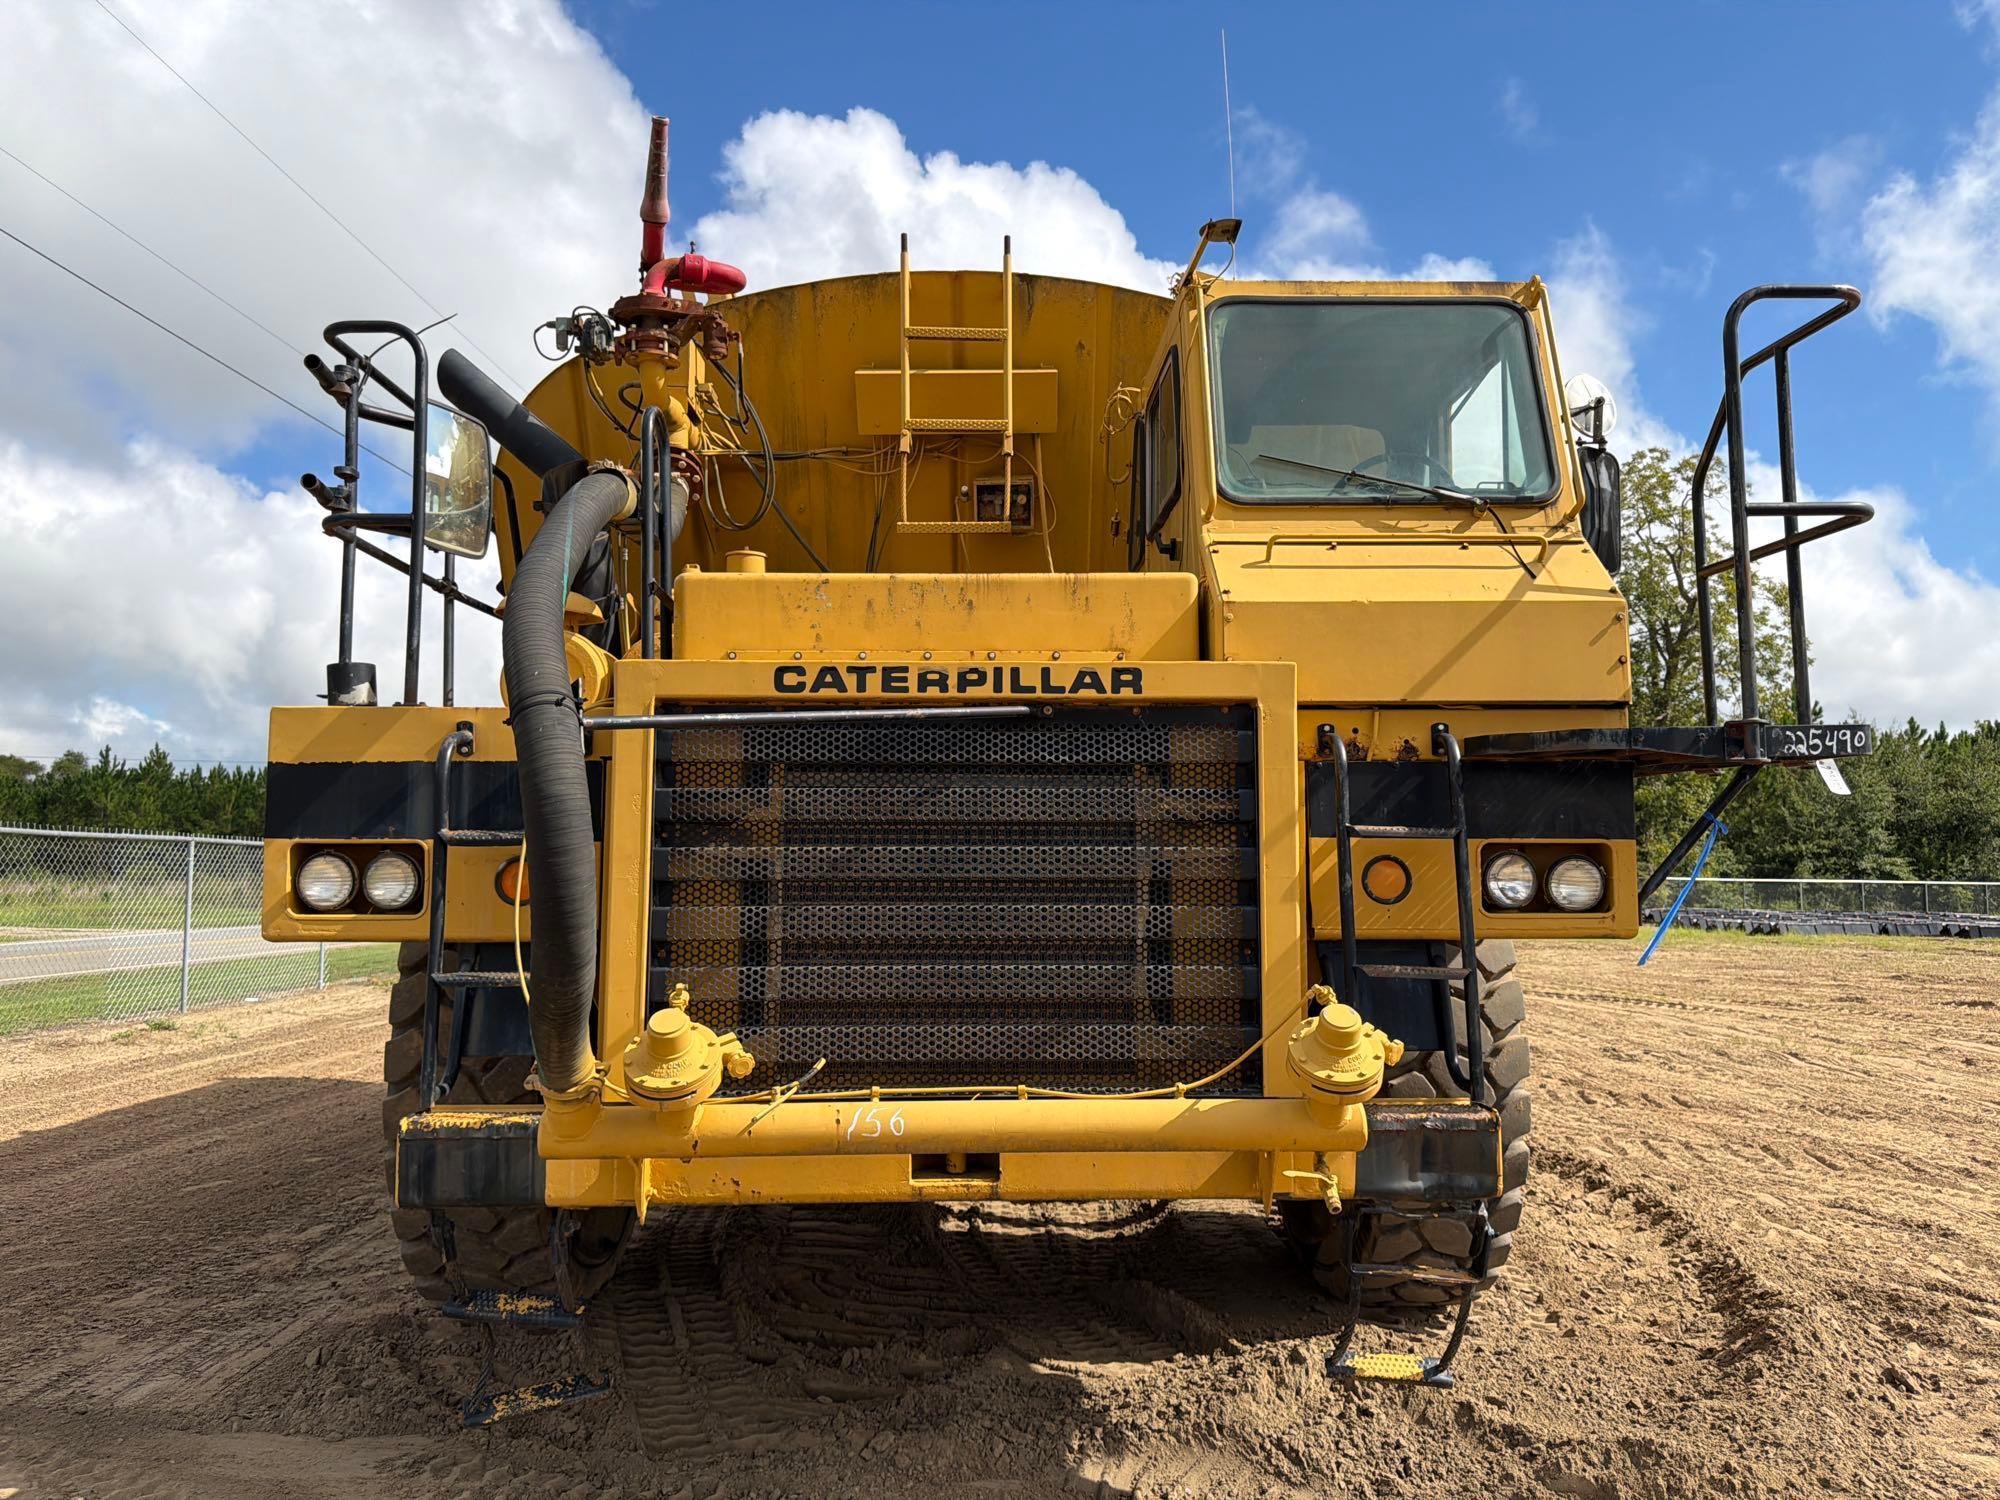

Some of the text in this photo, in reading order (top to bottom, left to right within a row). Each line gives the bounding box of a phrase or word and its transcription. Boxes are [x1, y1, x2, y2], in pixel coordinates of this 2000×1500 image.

[773, 665, 1143, 695] CATERPILLAR
[1784, 728, 1866, 756] 225490
[847, 1107, 905, 1141] 156
